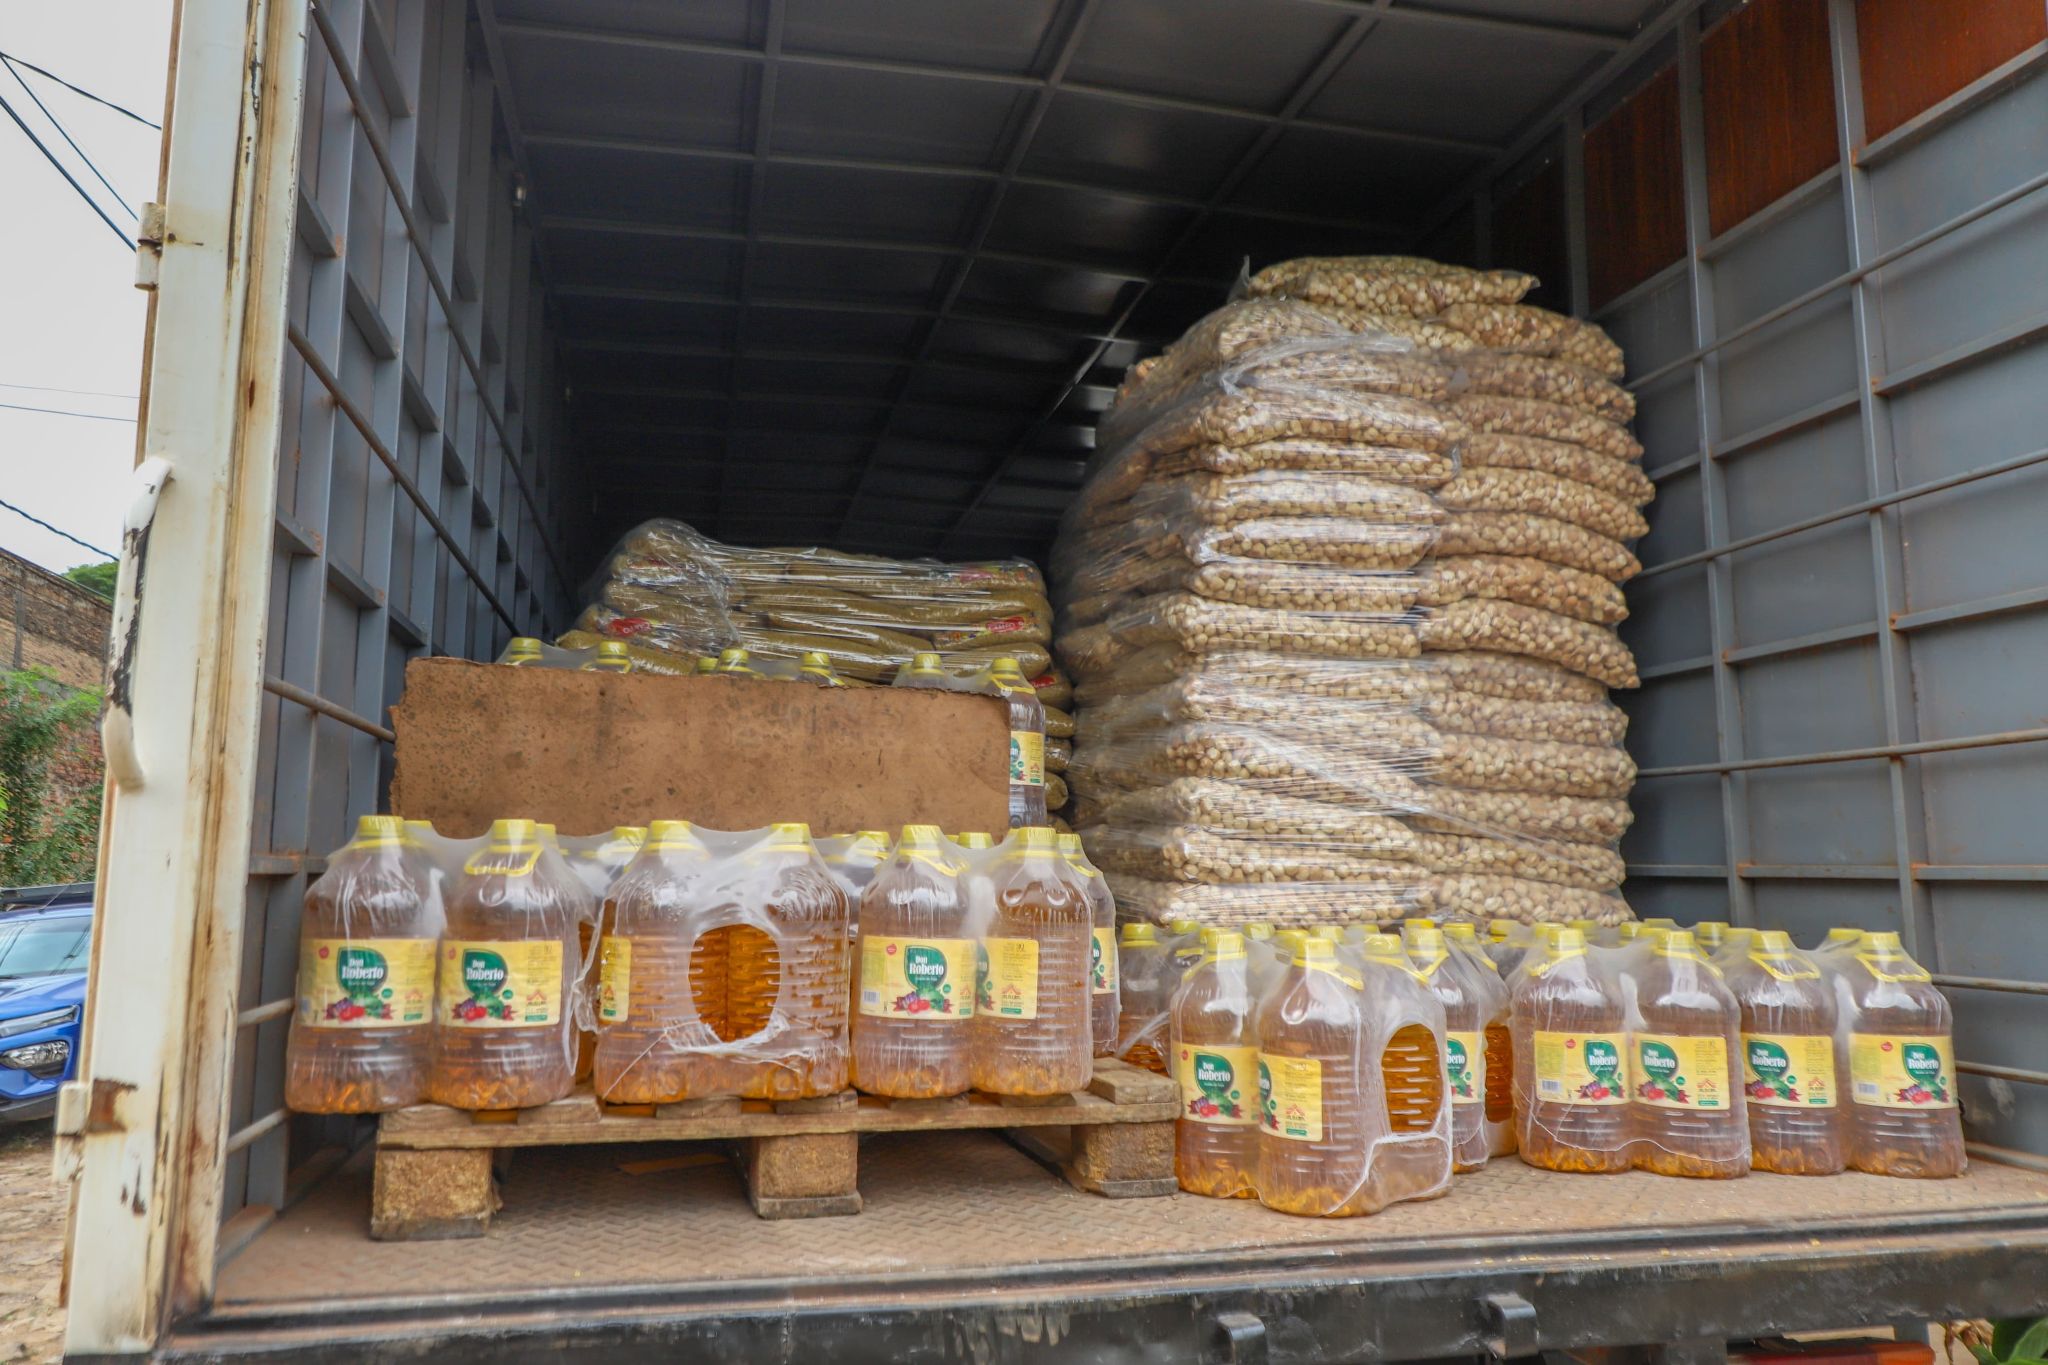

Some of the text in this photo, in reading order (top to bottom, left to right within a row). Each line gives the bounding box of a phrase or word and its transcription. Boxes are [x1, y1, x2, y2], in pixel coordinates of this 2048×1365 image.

[348, 958, 364, 967] Don
[472, 960, 486, 969] Don
[915, 956, 928, 964] Don
[341, 966, 384, 979] Roberto
[466, 968, 504, 981] Roberto
[909, 963, 944, 976] Roberto
[1202, 1062, 1214, 1071] Don
[1588, 1055, 1618, 1066] Roberto
[1643, 1055, 1675, 1069] Roberto
[1751, 1054, 1786, 1068] Roberto
[1907, 1057, 1939, 1070] Roberto
[1197, 1068, 1231, 1082] Roberto
